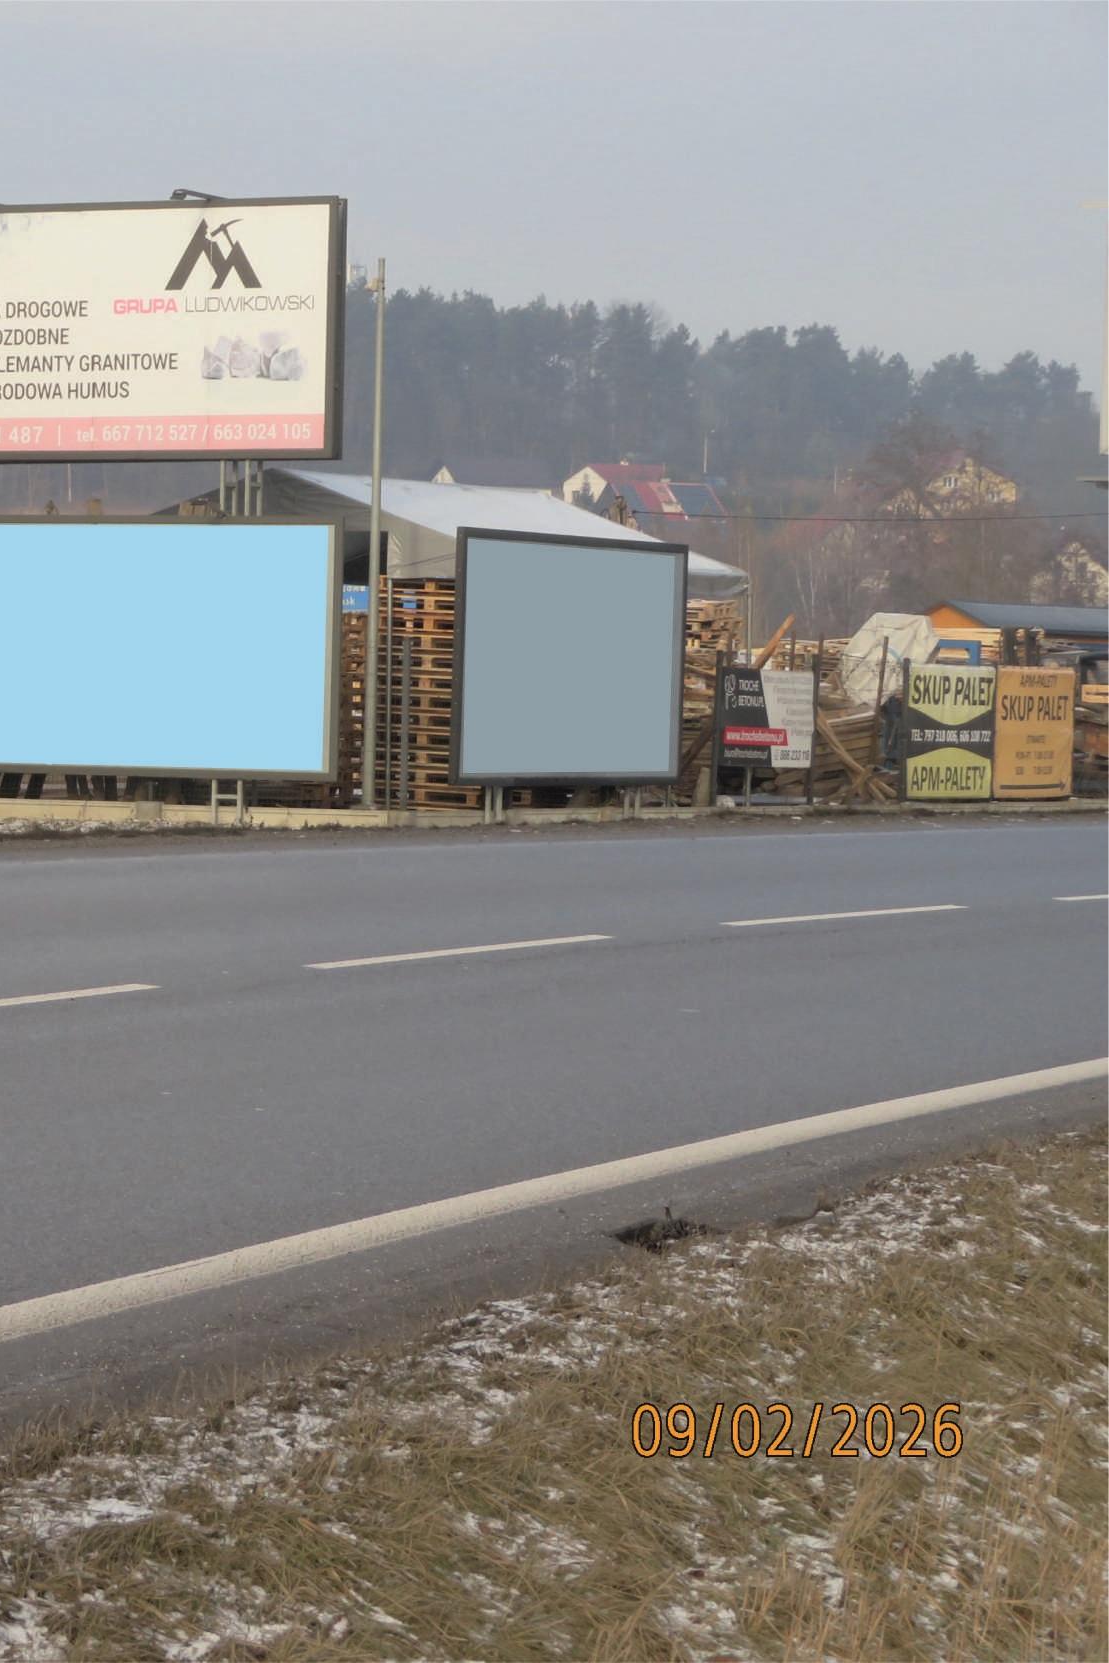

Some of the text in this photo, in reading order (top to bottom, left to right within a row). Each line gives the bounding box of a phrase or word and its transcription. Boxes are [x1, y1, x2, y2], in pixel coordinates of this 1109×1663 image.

[5, 300, 89, 319] DROGOWE
[113, 295, 315, 315] GRUPA LUDWIKOWSKI
[79, 353, 179, 373] GRANITOWE
[67, 381, 130, 400] HUMUS
[8, 426, 44, 443] 487
[76, 429, 96, 442] tel.
[102, 426, 130, 442] 667
[135, 425, 164, 441] 712
[169, 424, 197, 441] 527
[214, 423, 243, 440] 663
[247, 423, 277, 440] 024
[283, 423, 311, 440] 105
[912, 674, 994, 706] SKUP PALET
[1020, 674, 1058, 688] APM-PALETY
[1001, 694, 1069, 721] SKUP PALET
[911, 766, 986, 791] APM-PALETY
